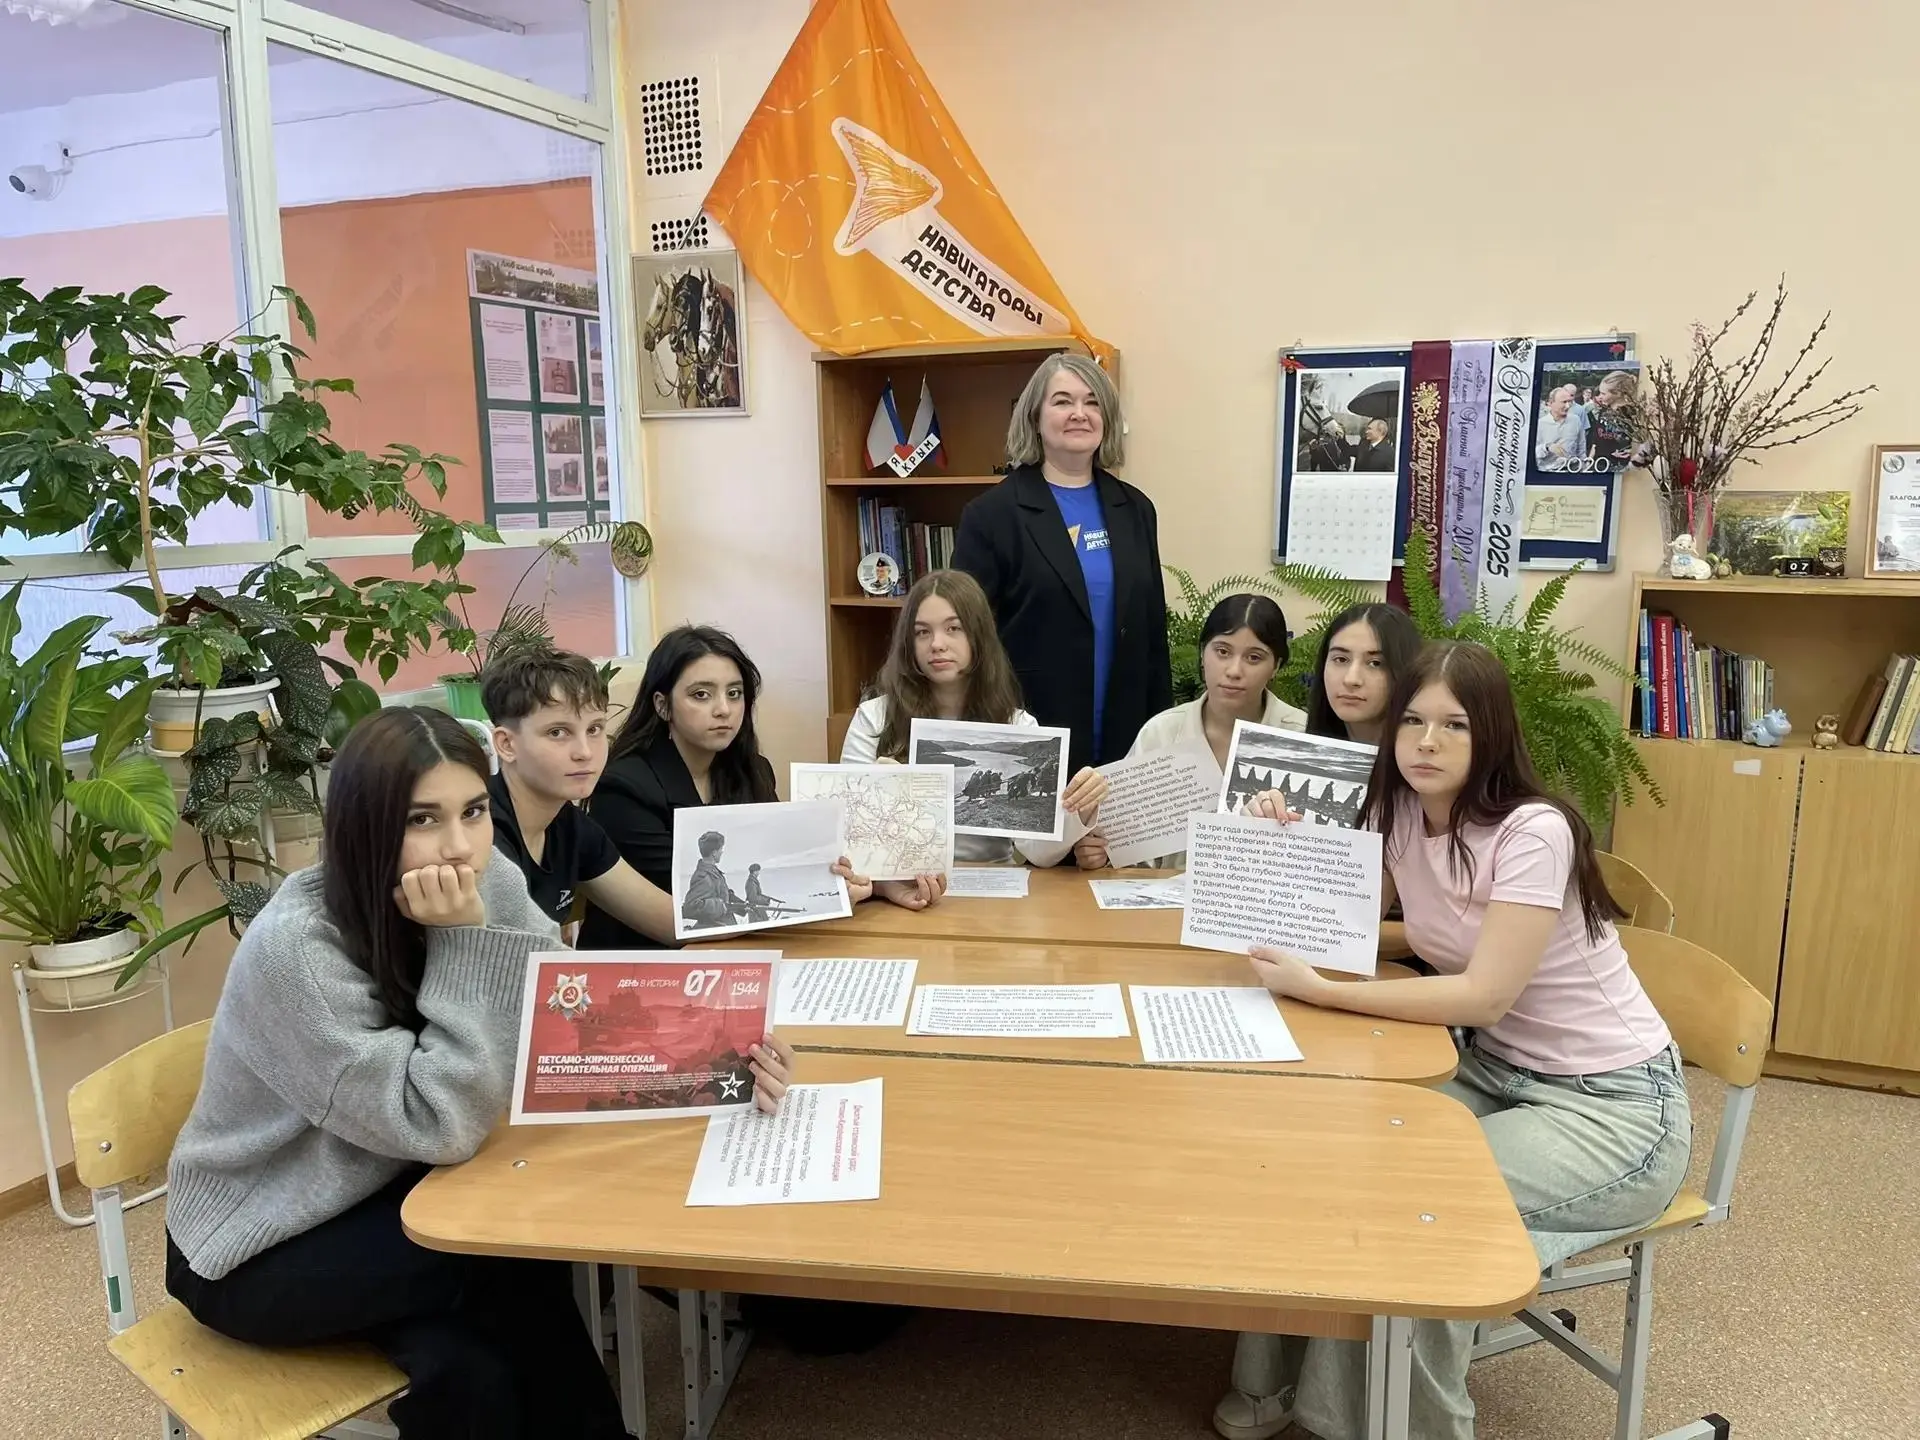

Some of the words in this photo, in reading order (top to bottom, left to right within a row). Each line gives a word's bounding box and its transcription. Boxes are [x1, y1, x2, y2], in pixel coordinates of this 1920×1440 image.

[900, 249, 996, 322] ДЕТСТВА
[918, 224, 1043, 325] НАВИГАТОРЫ
[1494, 364, 1531, 481] Классный
[891, 457, 900, 467] Я
[901, 439, 934, 473] КРЫМ
[1492, 412, 1512, 516] руководитель
[1558, 456, 1610, 474] 2020
[1086, 538, 1110, 551] ДЕТСТ
[1452, 525, 1474, 565] 2024
[1487, 523, 1512, 578] 2025
[1662, 703, 1670, 732] КРАСНАЯ
[1196, 822, 1206, 830] За
[1209, 824, 1221, 832] три
[1223, 826, 1241, 834] года
[1243, 828, 1284, 838] оккупации
[1285, 833, 1352, 848] горнострелковый
[1196, 834, 1222, 842] корпус
[1288, 844, 1350, 857] командованием
[1196, 842, 1232, 852] генерала
[1233, 846, 1260, 855] горных
[1262, 849, 1284, 858] войск
[1286, 852, 1335, 865] Фердинанда
[1337, 858, 1362, 869] Йодля
[1224, 855, 1246, 863] здесь
[1262, 860, 1312, 871] называемый
[1314, 865, 1365, 880] Лапландский
[1212, 862, 1228, 870] Это
[1229, 864, 1250, 872] была
[1252, 868, 1282, 877] глубоко
[1194, 870, 1224, 878] мощная
[1226, 873, 1290, 888] оборонительная
[1329, 888, 1372, 900] врезанная
[1200, 880, 1240, 890] гранитные
[1270, 890, 1296, 900] тундру
[1192, 898, 1232, 908] опиралась
[1246, 906, 1310, 921] господствующие
[1194, 888, 1266, 904] труднопроходимые
[1300, 902, 1336, 914] Оборона
[1192, 908, 1276, 926] трансформированные
[1284, 922, 1328, 934] настоящие
[1330, 928, 1366, 940] крепости
[1196, 918, 1266, 934] долговременными
[1268, 928, 1306, 940] огневыми
[1256, 936, 1296, 948] глубокими
[1297, 944, 1328, 954] ходами
[617, 978, 640, 988] ДЕНЬ
[640, 978, 646, 988] В
[646, 978, 680, 988] ИСТОРИИ
[683, 968, 722, 998] 07
[731, 968, 762, 978] ОКТЯБРЯ
[731, 982, 760, 996] 1944
[536, 1064, 620, 1074] НАСТУПАТЕЛЬНАЯ
[620, 1063, 668, 1074] ОПЕРАЦИЯ
[538, 1054, 655, 1064] ПЕТСАМО-КИРКЕНЕССКАЯ
